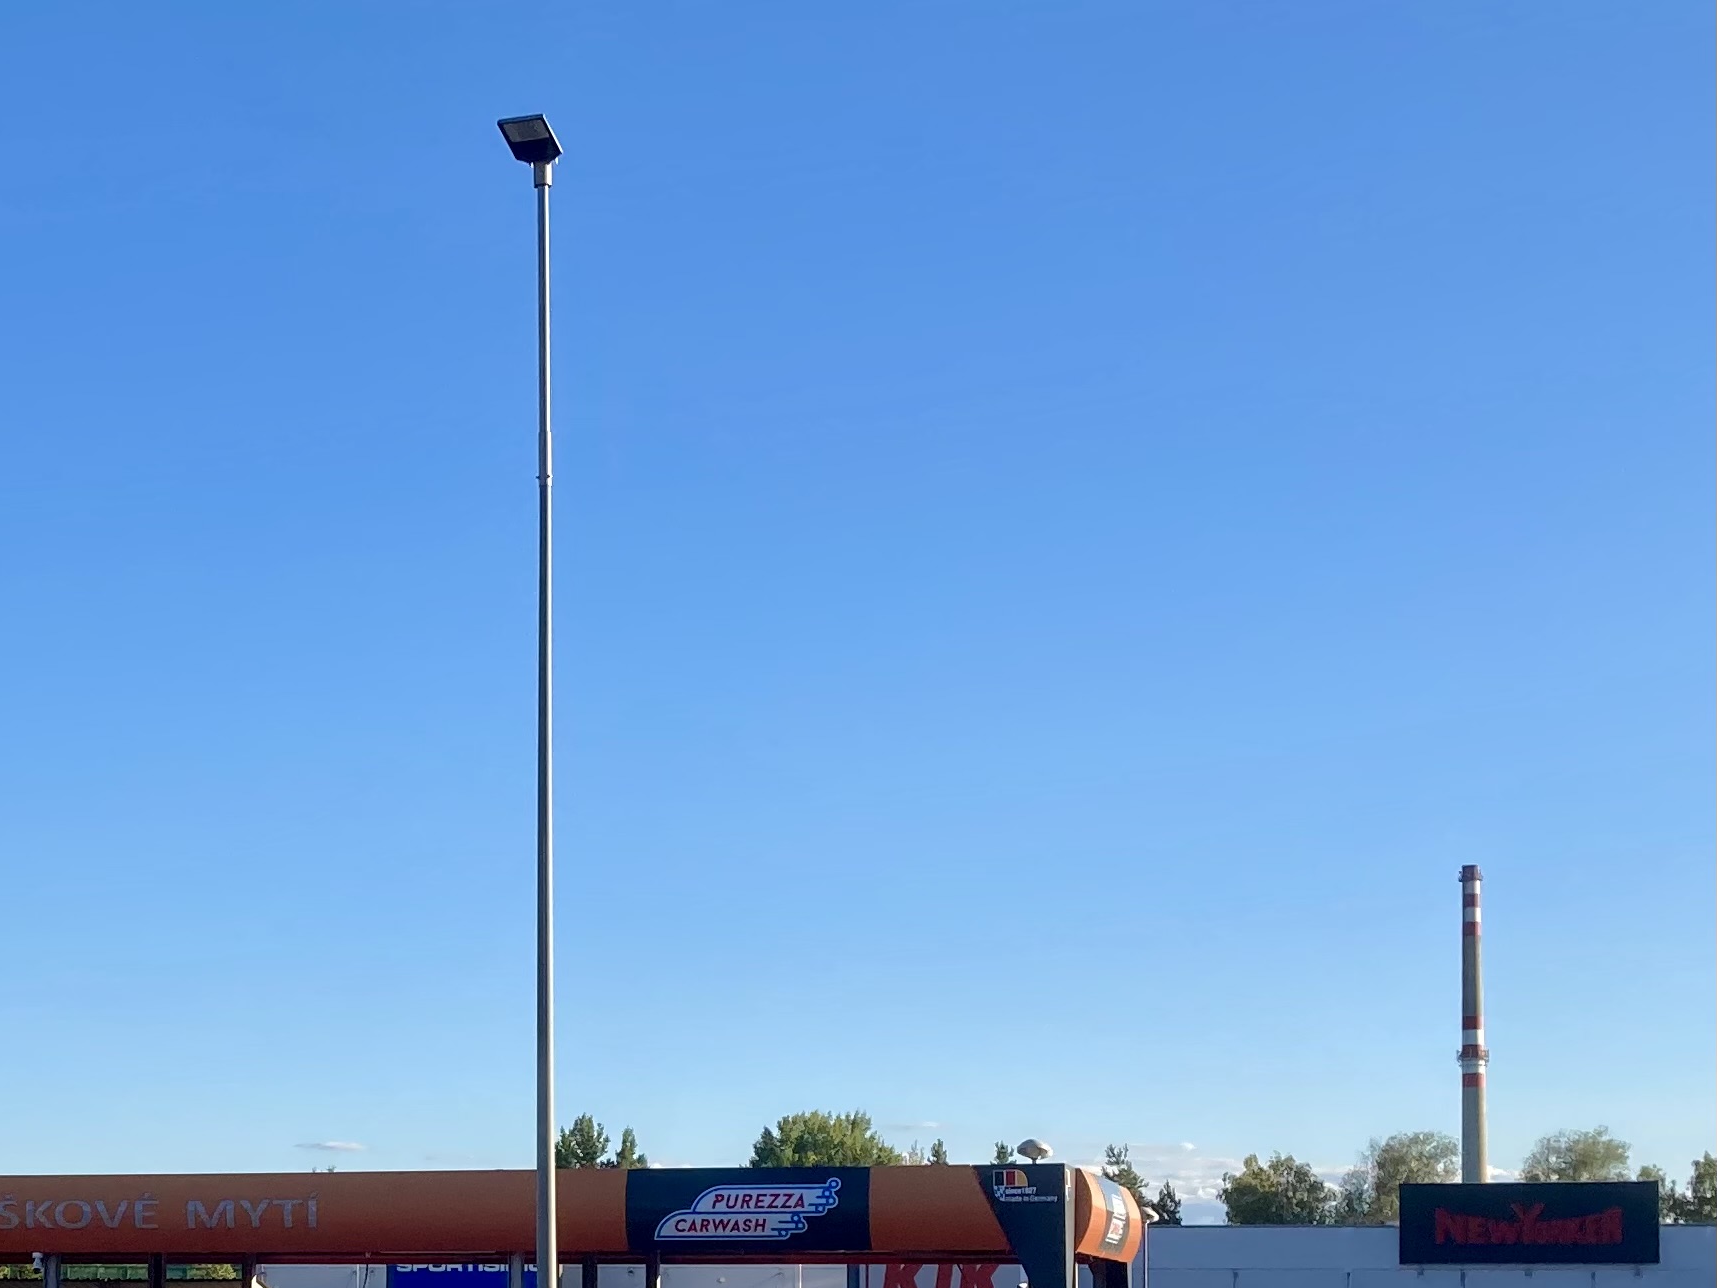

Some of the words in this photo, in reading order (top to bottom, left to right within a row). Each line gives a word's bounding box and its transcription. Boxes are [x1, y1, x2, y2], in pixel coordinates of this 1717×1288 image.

[711, 1192, 806, 1210] PUREZZA
[185, 1192, 320, 1230] MYTÍ
[674, 1217, 768, 1234] CARWASH
